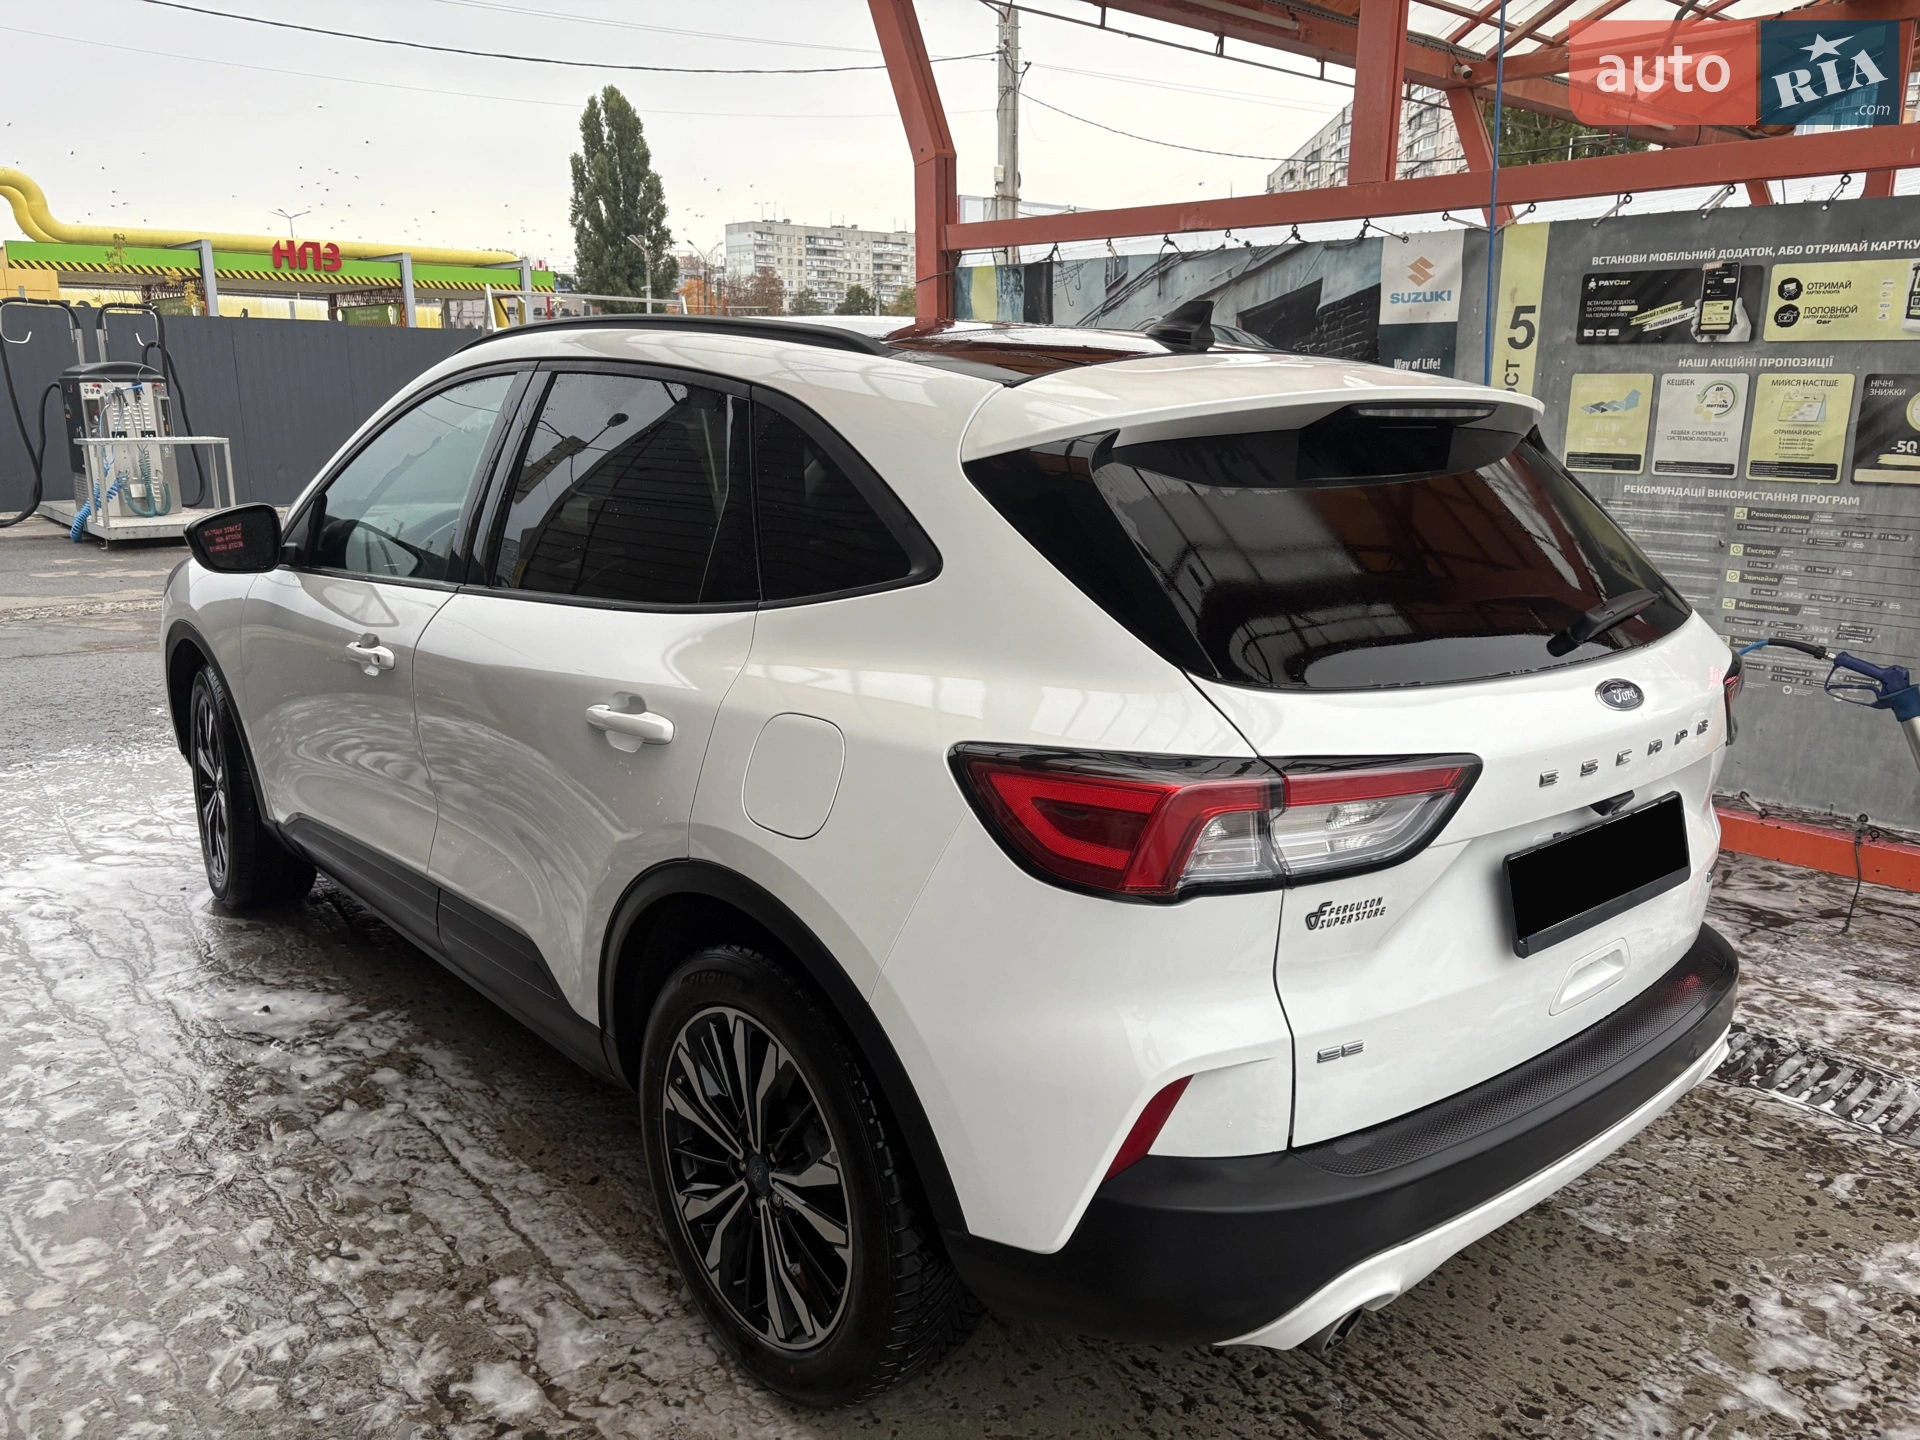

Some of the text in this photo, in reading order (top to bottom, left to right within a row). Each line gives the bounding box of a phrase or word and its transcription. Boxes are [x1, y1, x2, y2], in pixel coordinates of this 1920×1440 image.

[271, 239, 342, 272] НПЗ
[1591, 239, 1920, 266] ВСТАНОВИ МОБІЛЬНИЙ ДОДАТОК, АБО ОТРИМАЙ КАРТКУ
[1598, 279, 1631, 287] PAYCar
[1807, 280, 1852, 290] ОТРИМАЙ
[1389, 290, 1452, 304] SUZUKI
[1804, 305, 1858, 314] ПОПОВНЮЙ
[1507, 305, 1536, 350] 5
[1393, 358, 1441, 371] Way of Life!
[1678, 355, 1835, 368] НАШІ АКЦІЙНІ ПРОПОЗИЦІЇ
[1771, 379, 1801, 387] МИЙСЯ
[1870, 379, 1894, 387] НІЧНІ
[1869, 388, 1906, 396] ЗНИЖКИ
[1707, 489, 1799, 503] ВИКОРИСТАННЯ
[1800, 494, 1861, 506] ПРОГРАМ
[1751, 510, 1810, 521] Рекомендована
[1746, 547, 1776, 555] Експрес
[1743, 573, 1778, 583] Звичайна
[1738, 601, 1790, 612] Максимальна
[1610, 683, 1639, 703] Ford
[1538, 719, 1709, 788] ESCAPE
[1328, 896, 1383, 917] FERGUSON
[1316, 1039, 1364, 1063] SE
